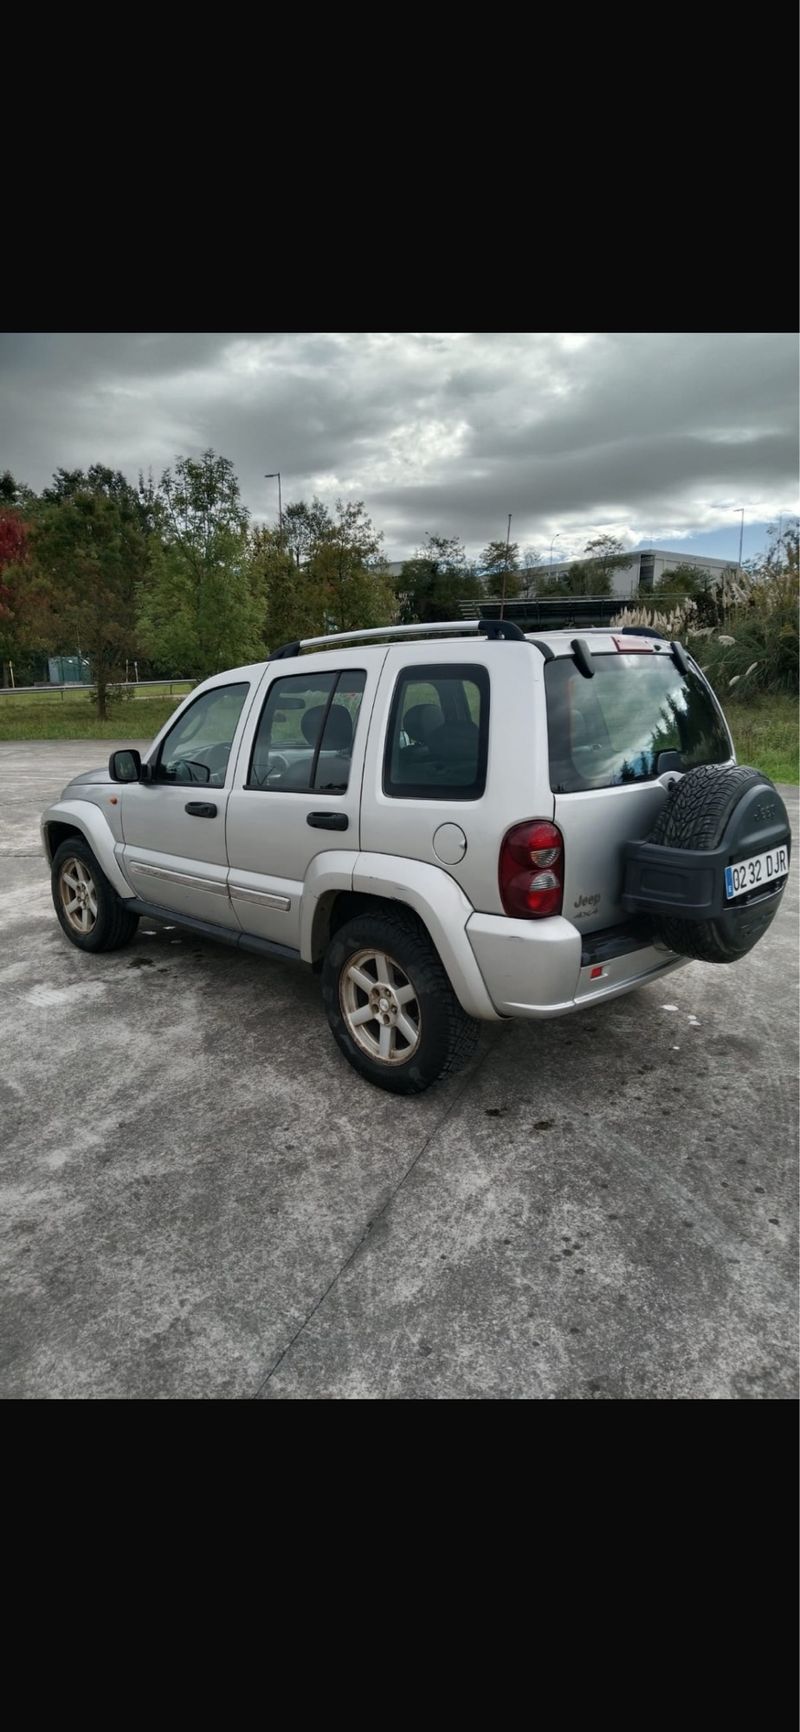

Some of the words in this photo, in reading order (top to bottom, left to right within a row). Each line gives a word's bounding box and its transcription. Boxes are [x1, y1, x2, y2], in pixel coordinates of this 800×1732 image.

[733, 860, 762, 891] 0232
[766, 850, 786, 877] DJR
[574, 893, 600, 908] Jeep
